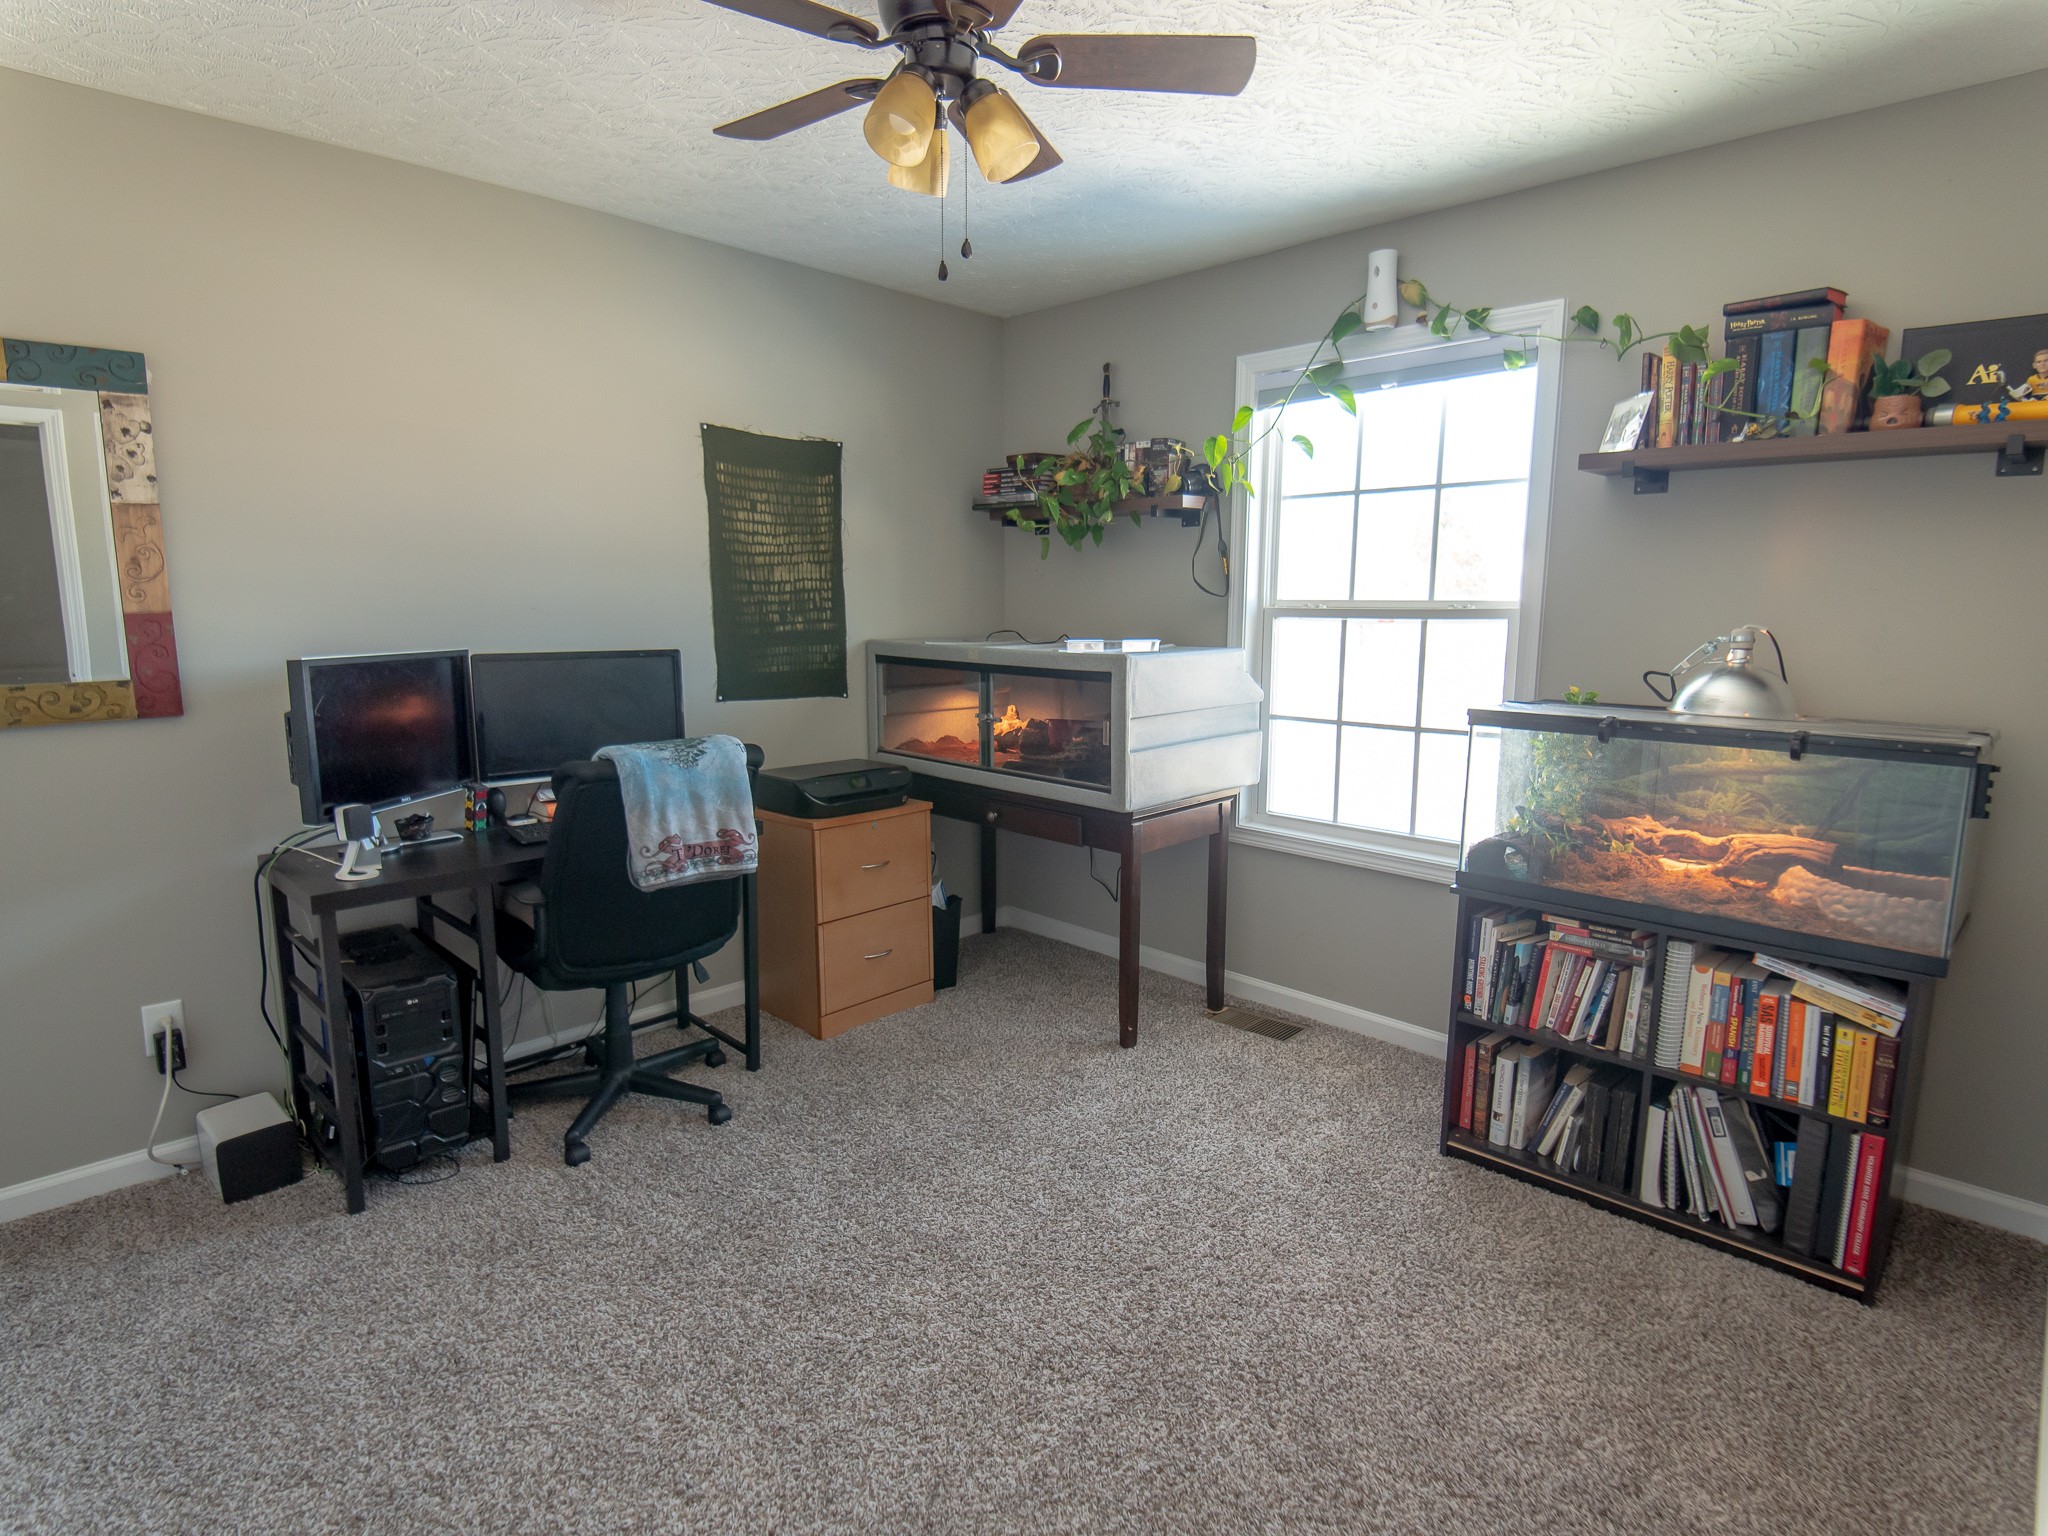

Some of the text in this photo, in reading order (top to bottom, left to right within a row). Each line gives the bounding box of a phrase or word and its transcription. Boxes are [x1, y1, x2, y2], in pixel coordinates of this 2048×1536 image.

[1731, 321, 1748, 330] HARRY
[1747, 319, 1767, 327] POTTER
[1740, 354, 1748, 384] HARRY
[1664, 361, 1675, 414] HARRY POTTER
[1467, 959, 1475, 980] HUNTING
[1478, 956, 1487, 978] STALKING
[1477, 979, 1485, 999] GROUND
[1687, 1010, 1696, 1038] Thesaurus
[1692, 983, 1708, 1058] Webster's New Dictionary
[1760, 1004, 1775, 1024] SAS
[1728, 1016, 1739, 1048] SPANISH
[1756, 1024, 1766, 1054] HANDBOOK
[1764, 1025, 1773, 1055] SURVIVAL
[1466, 1069, 1474, 1097] ROWLING
[1496, 1063, 1506, 1109] NICHOLAS SPARKS
[1517, 1074, 1528, 1106] Unwritten
[1831, 1049, 1844, 1107] THESAURUS
[1853, 1155, 1875, 1255] VOLUNTEER STATE COMMUNITY COLLEGE
